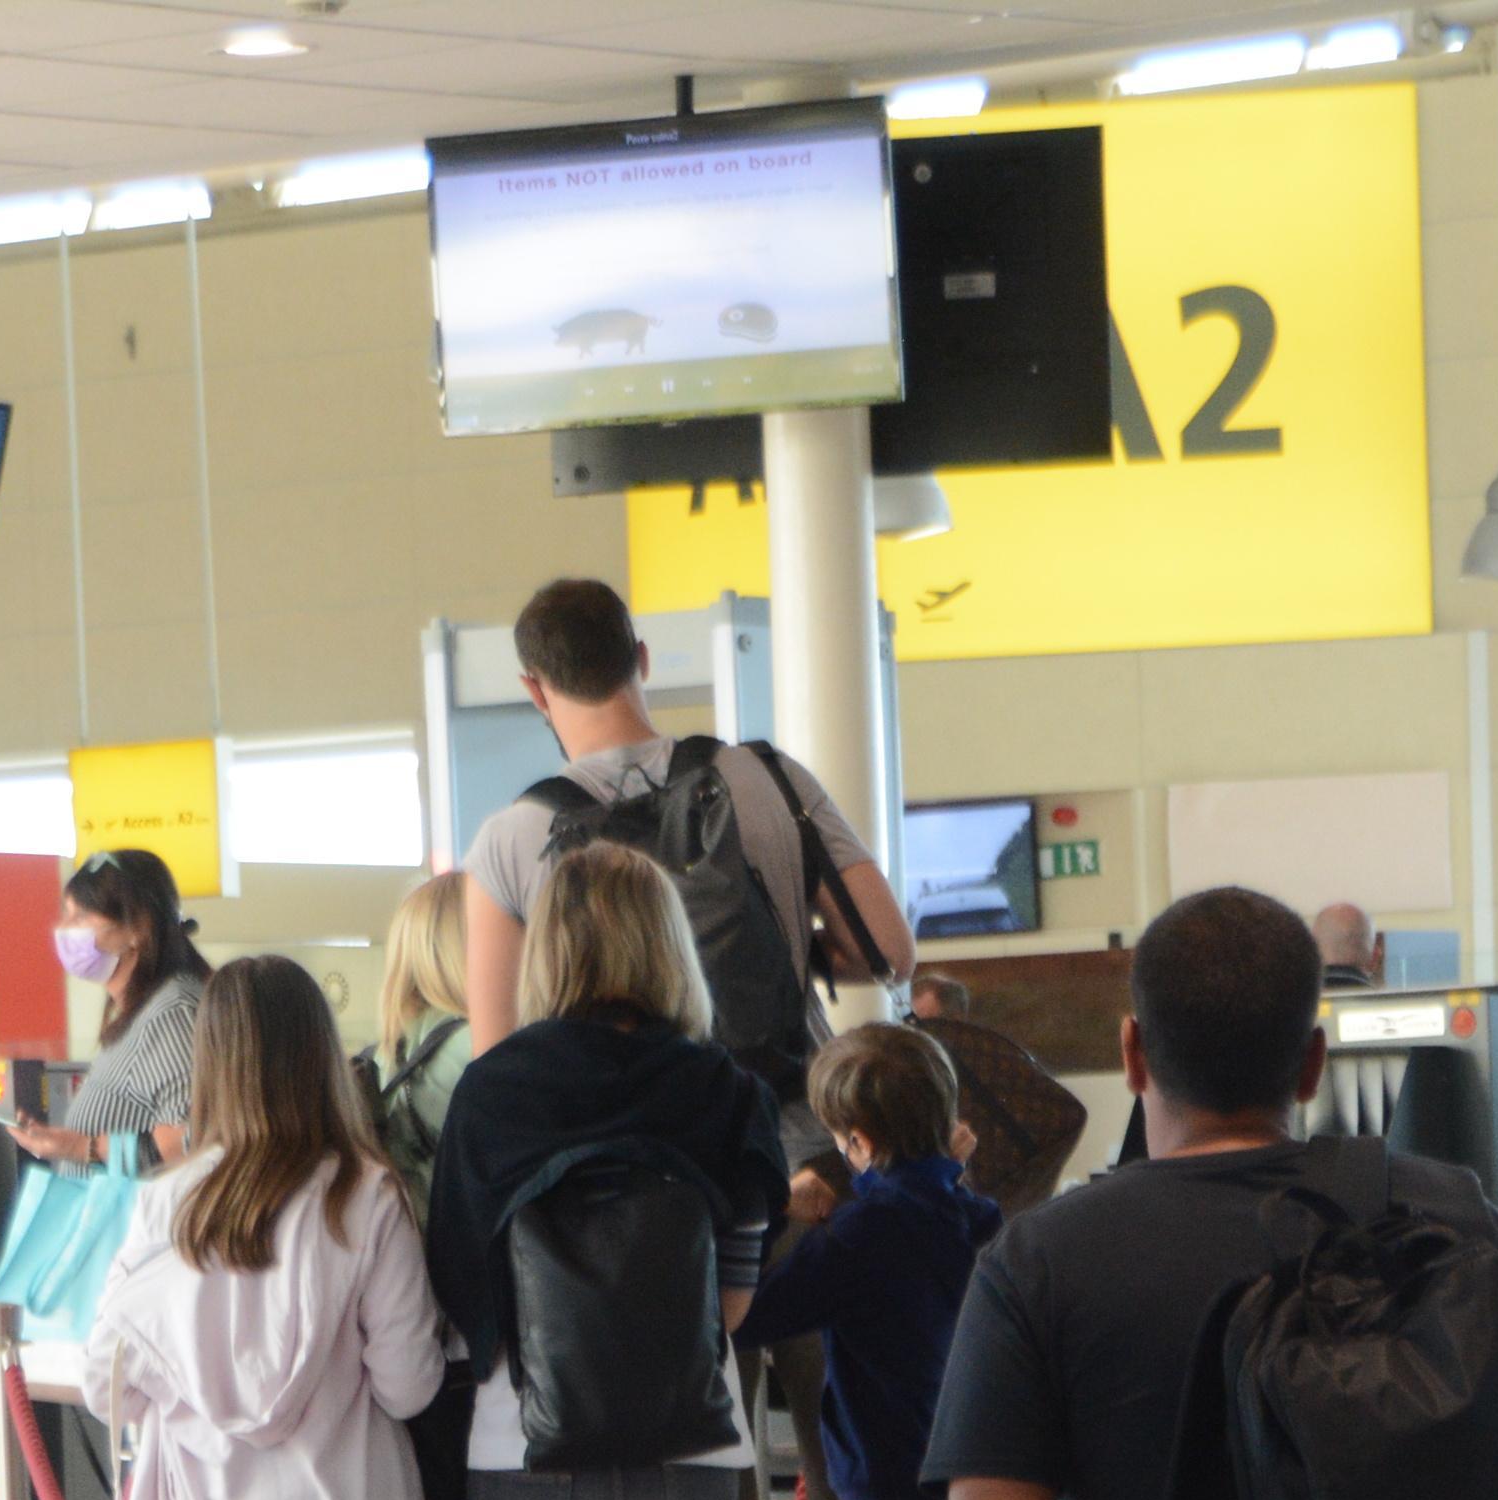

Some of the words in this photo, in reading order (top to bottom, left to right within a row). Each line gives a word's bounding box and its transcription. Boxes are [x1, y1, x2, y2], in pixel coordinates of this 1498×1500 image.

[498, 175, 557, 194] Items
[566, 171, 610, 188] NOT
[620, 162, 704, 183] allowed
[713, 159, 740, 174] on
[749, 150, 812, 171] board
